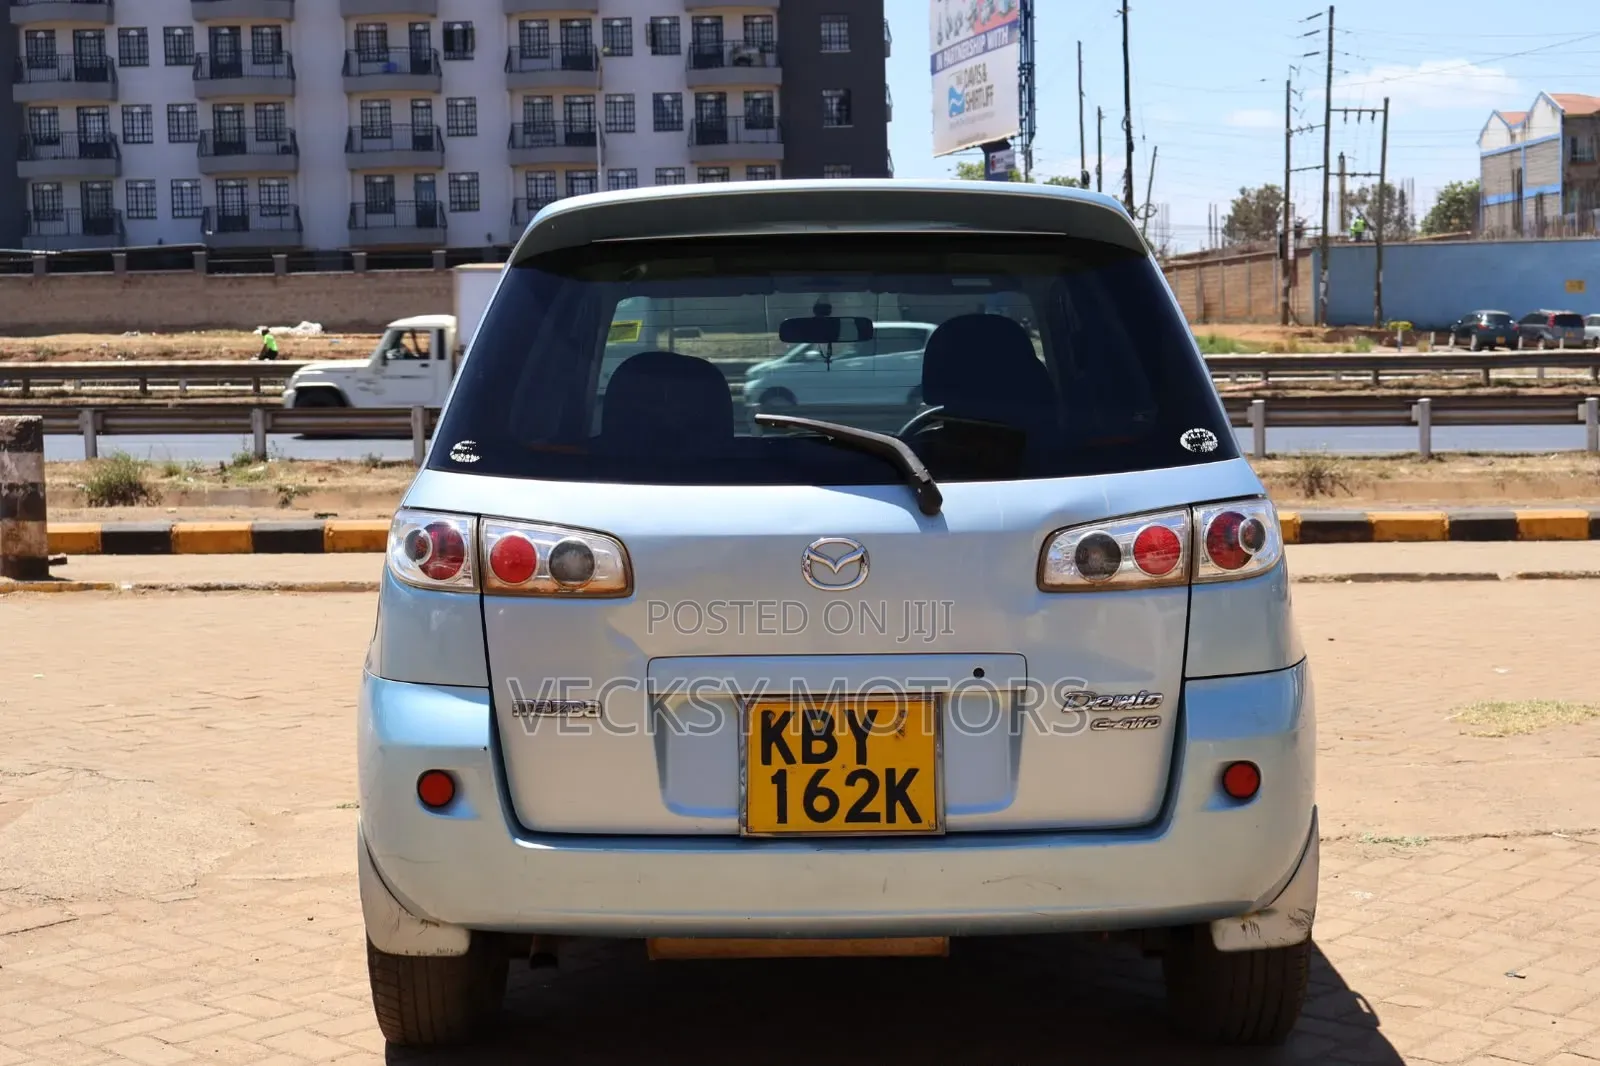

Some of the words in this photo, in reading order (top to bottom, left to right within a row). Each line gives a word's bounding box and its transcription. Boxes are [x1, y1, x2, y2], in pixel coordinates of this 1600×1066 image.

[944, 34, 986, 67] PARTNERSHIP
[987, 25, 1009, 50] WITH
[1062, 691, 1164, 712] Demio
[760, 709, 878, 766] KBY
[770, 768, 923, 825] 162K
